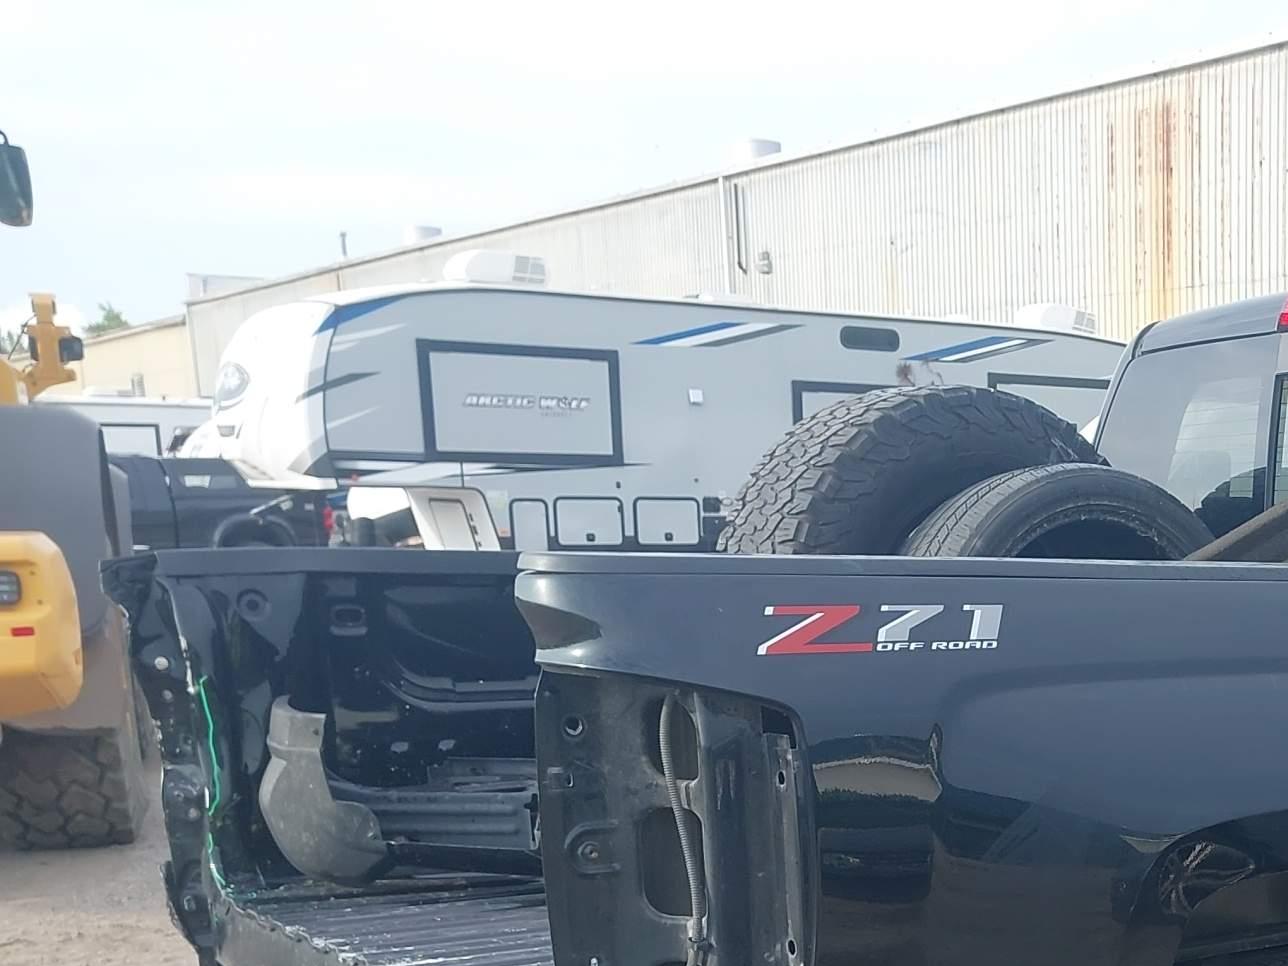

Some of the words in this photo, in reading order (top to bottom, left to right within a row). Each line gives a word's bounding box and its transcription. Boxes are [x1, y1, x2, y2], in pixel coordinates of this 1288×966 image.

[462, 393, 536, 409] ARCTIC
[756, 604, 1003, 656] Z71
[876, 641, 925, 651] OFF
[931, 640, 998, 650] ROAD
